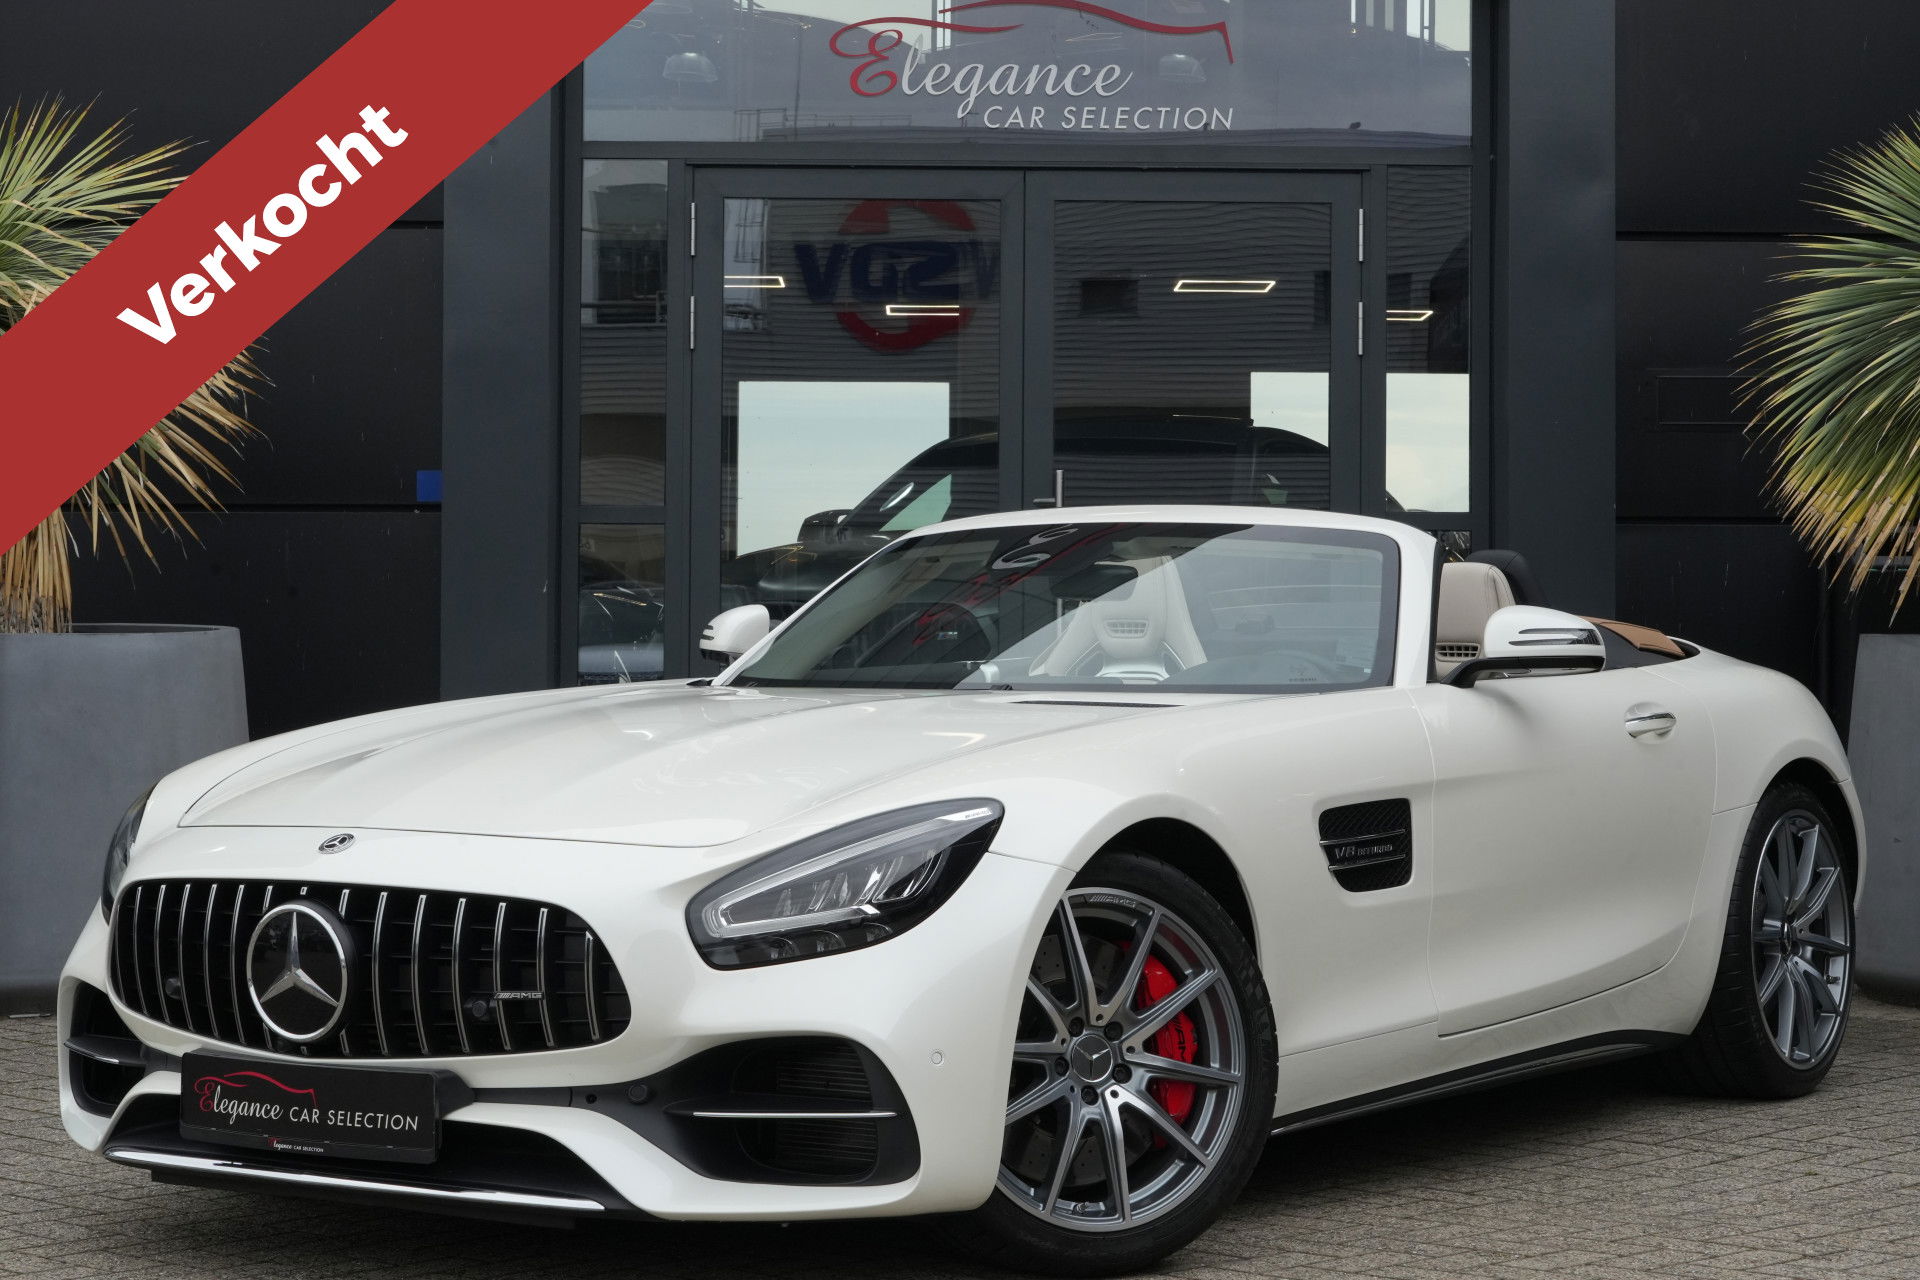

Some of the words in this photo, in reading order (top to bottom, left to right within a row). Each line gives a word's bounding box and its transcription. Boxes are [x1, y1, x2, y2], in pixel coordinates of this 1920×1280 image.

[829, 17, 1133, 118] Elegance
[984, 106, 1045, 129] CAR
[1061, 106, 1234, 130] SELECTION
[194, 1076, 284, 1124] Elegance
[289, 1106, 320, 1124] CAR
[327, 1110, 419, 1131] SELECTION
